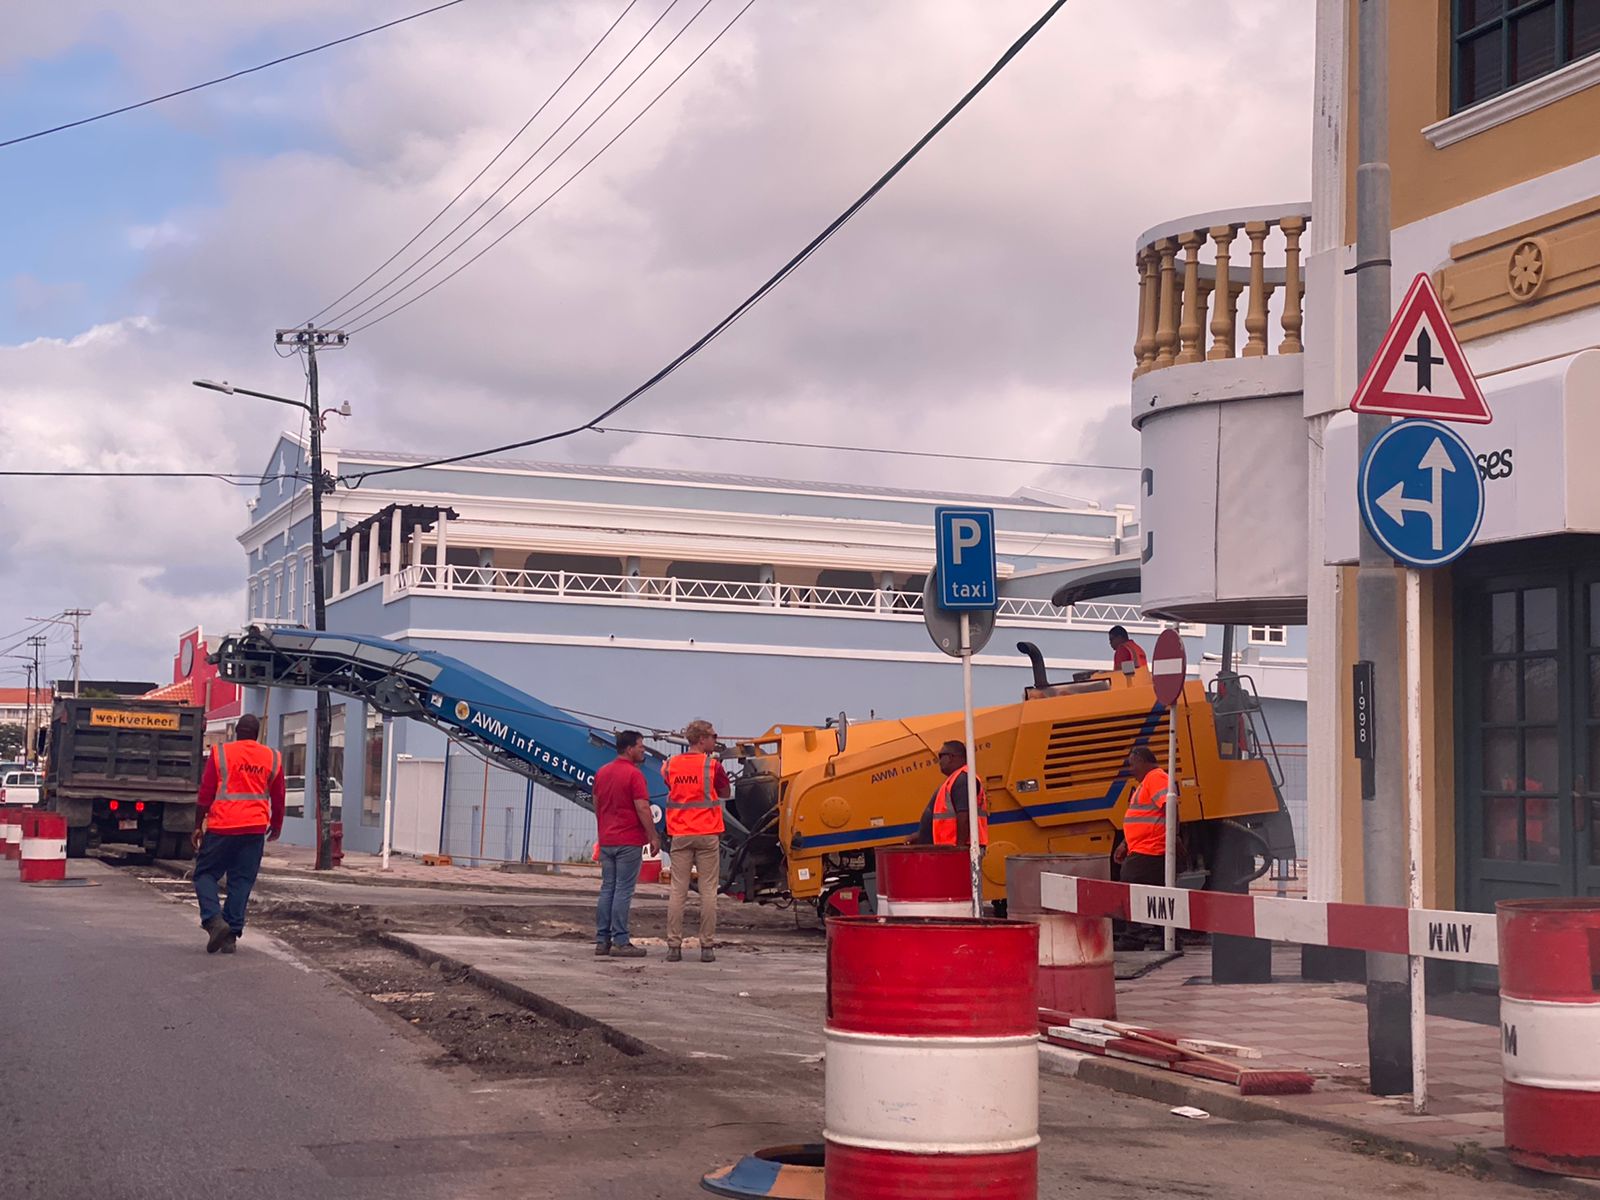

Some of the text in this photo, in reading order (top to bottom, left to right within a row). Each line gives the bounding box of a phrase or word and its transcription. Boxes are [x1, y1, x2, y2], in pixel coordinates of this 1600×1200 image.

[951, 517, 982, 565] P
[951, 580, 987, 598] taxi
[96, 713, 174, 727] werkverkeer
[1358, 680, 1367, 743] 1998
[471, 710, 509, 741] AWM
[238, 763, 265, 775] AWM
[673, 775, 699, 785] AWM
[871, 767, 898, 784] AWM
[1147, 895, 1175, 921] AWM
[1429, 922, 1472, 953] AWM
